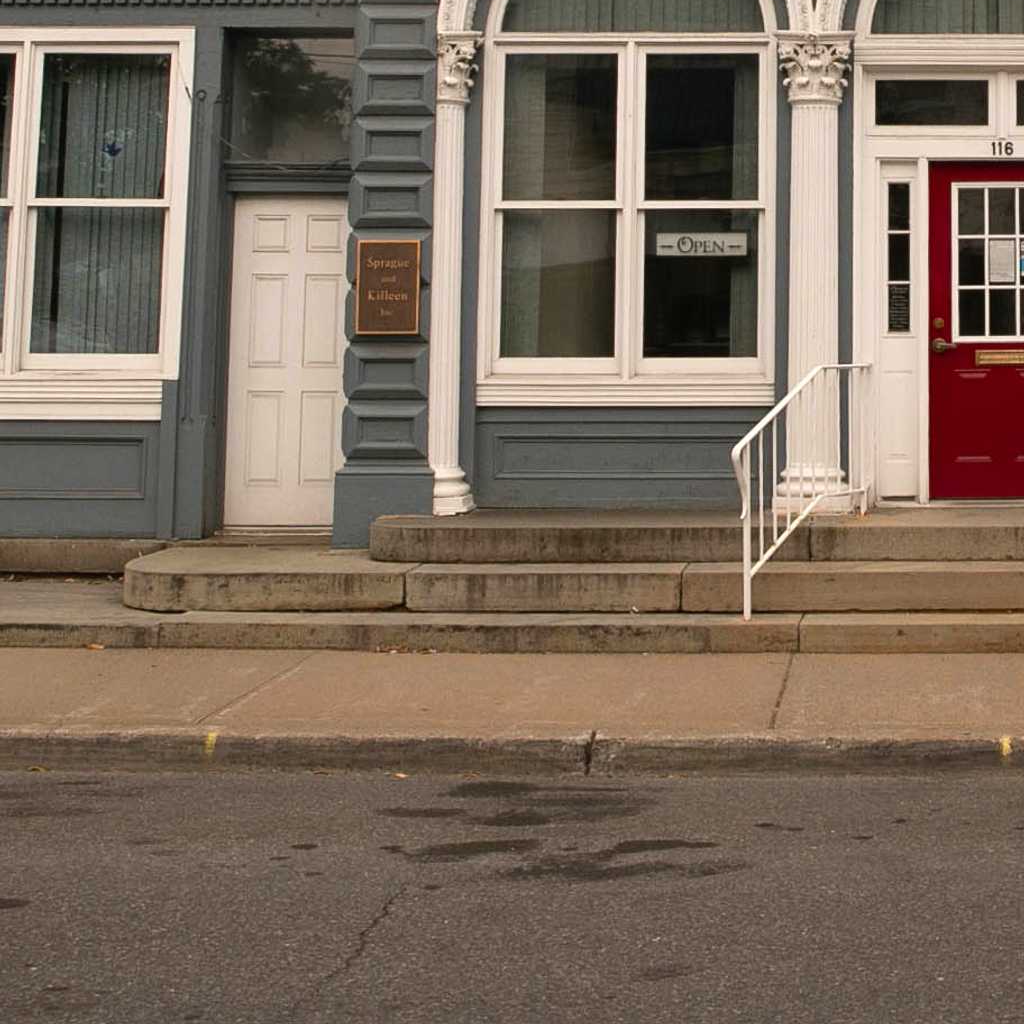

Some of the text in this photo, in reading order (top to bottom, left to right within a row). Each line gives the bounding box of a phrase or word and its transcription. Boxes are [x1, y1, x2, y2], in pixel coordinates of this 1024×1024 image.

[992, 142, 1014, 156] 116
[367, 256, 410, 269] Sprague
[367, 290, 408, 301] Killeen
